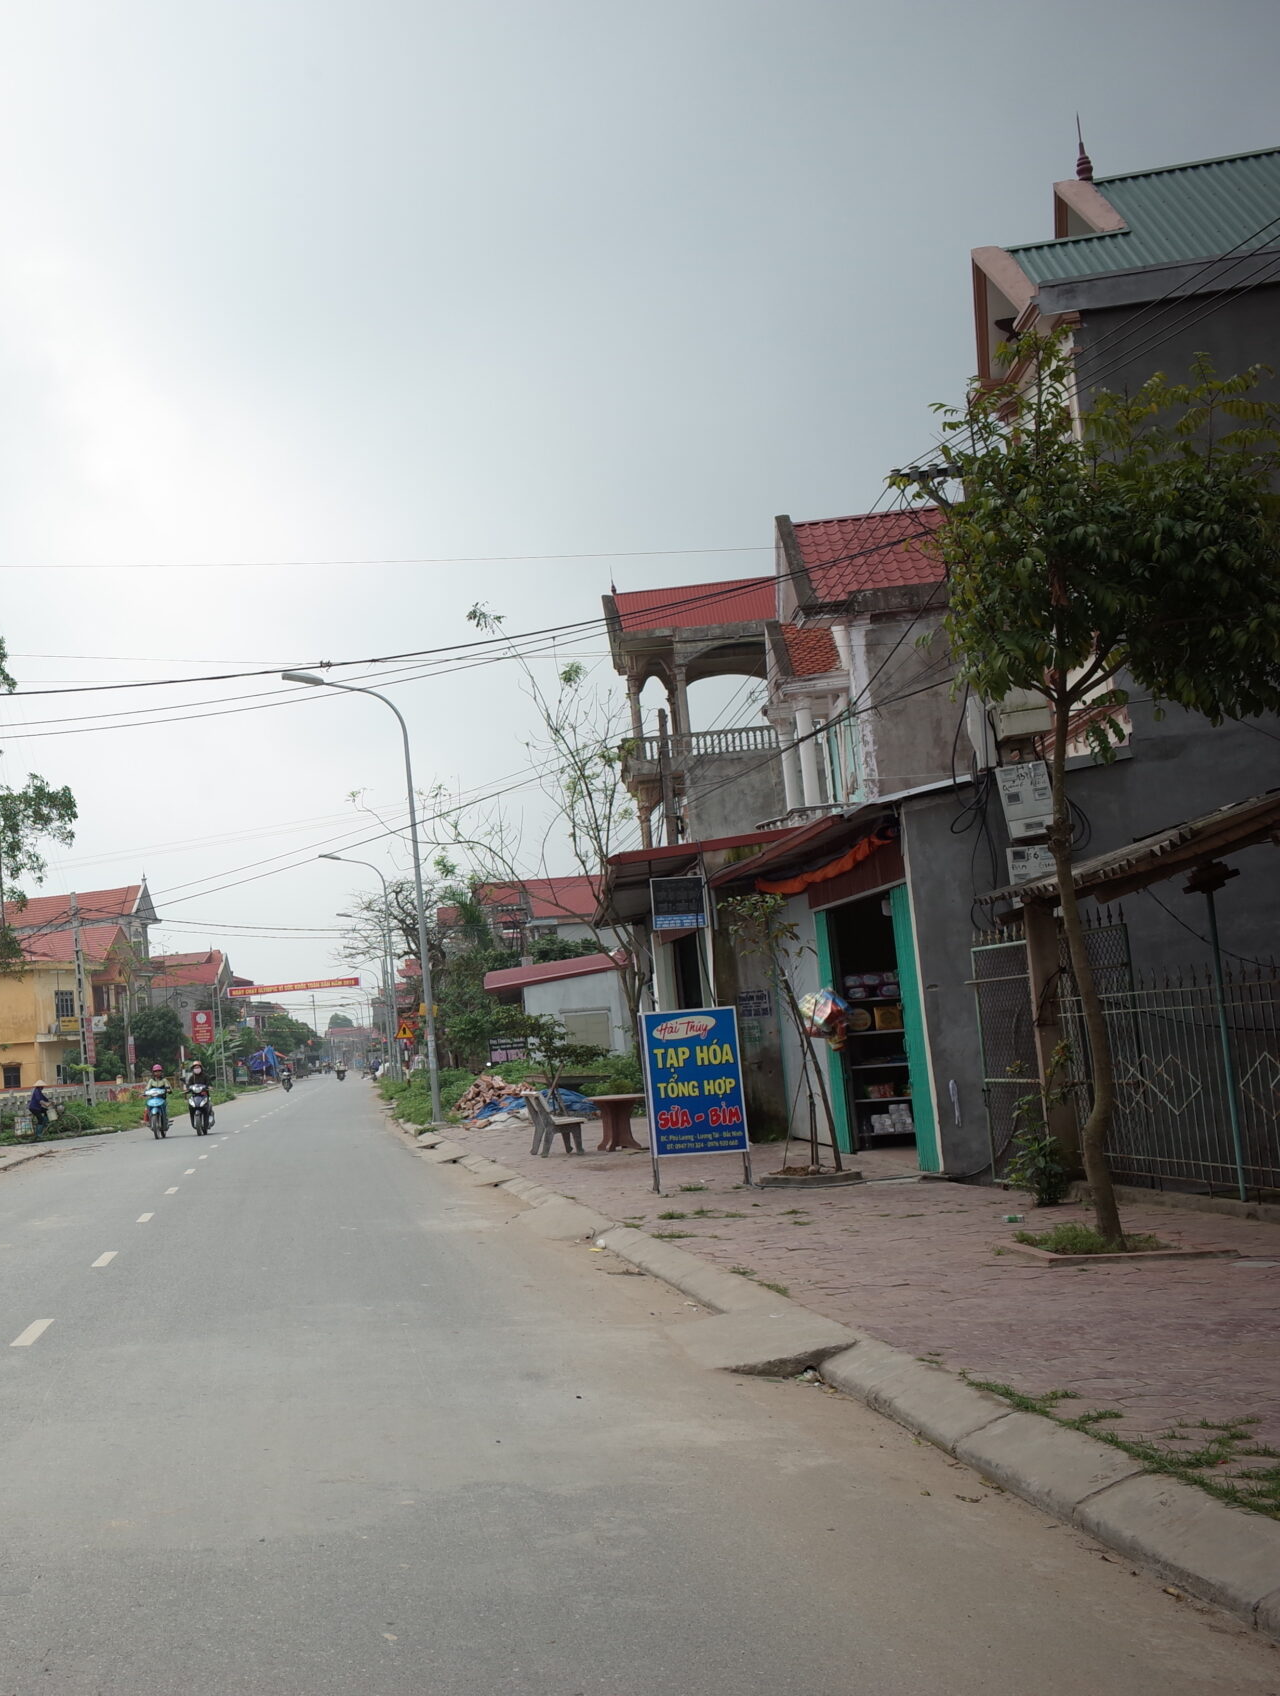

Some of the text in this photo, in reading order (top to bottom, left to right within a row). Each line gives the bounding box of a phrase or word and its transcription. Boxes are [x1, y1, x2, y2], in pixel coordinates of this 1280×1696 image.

[653, 1039, 734, 1072] TẠP HÓA
[657, 1074, 735, 1098] TỔNG HỢP
[658, 1105, 692, 1130] SỮA
